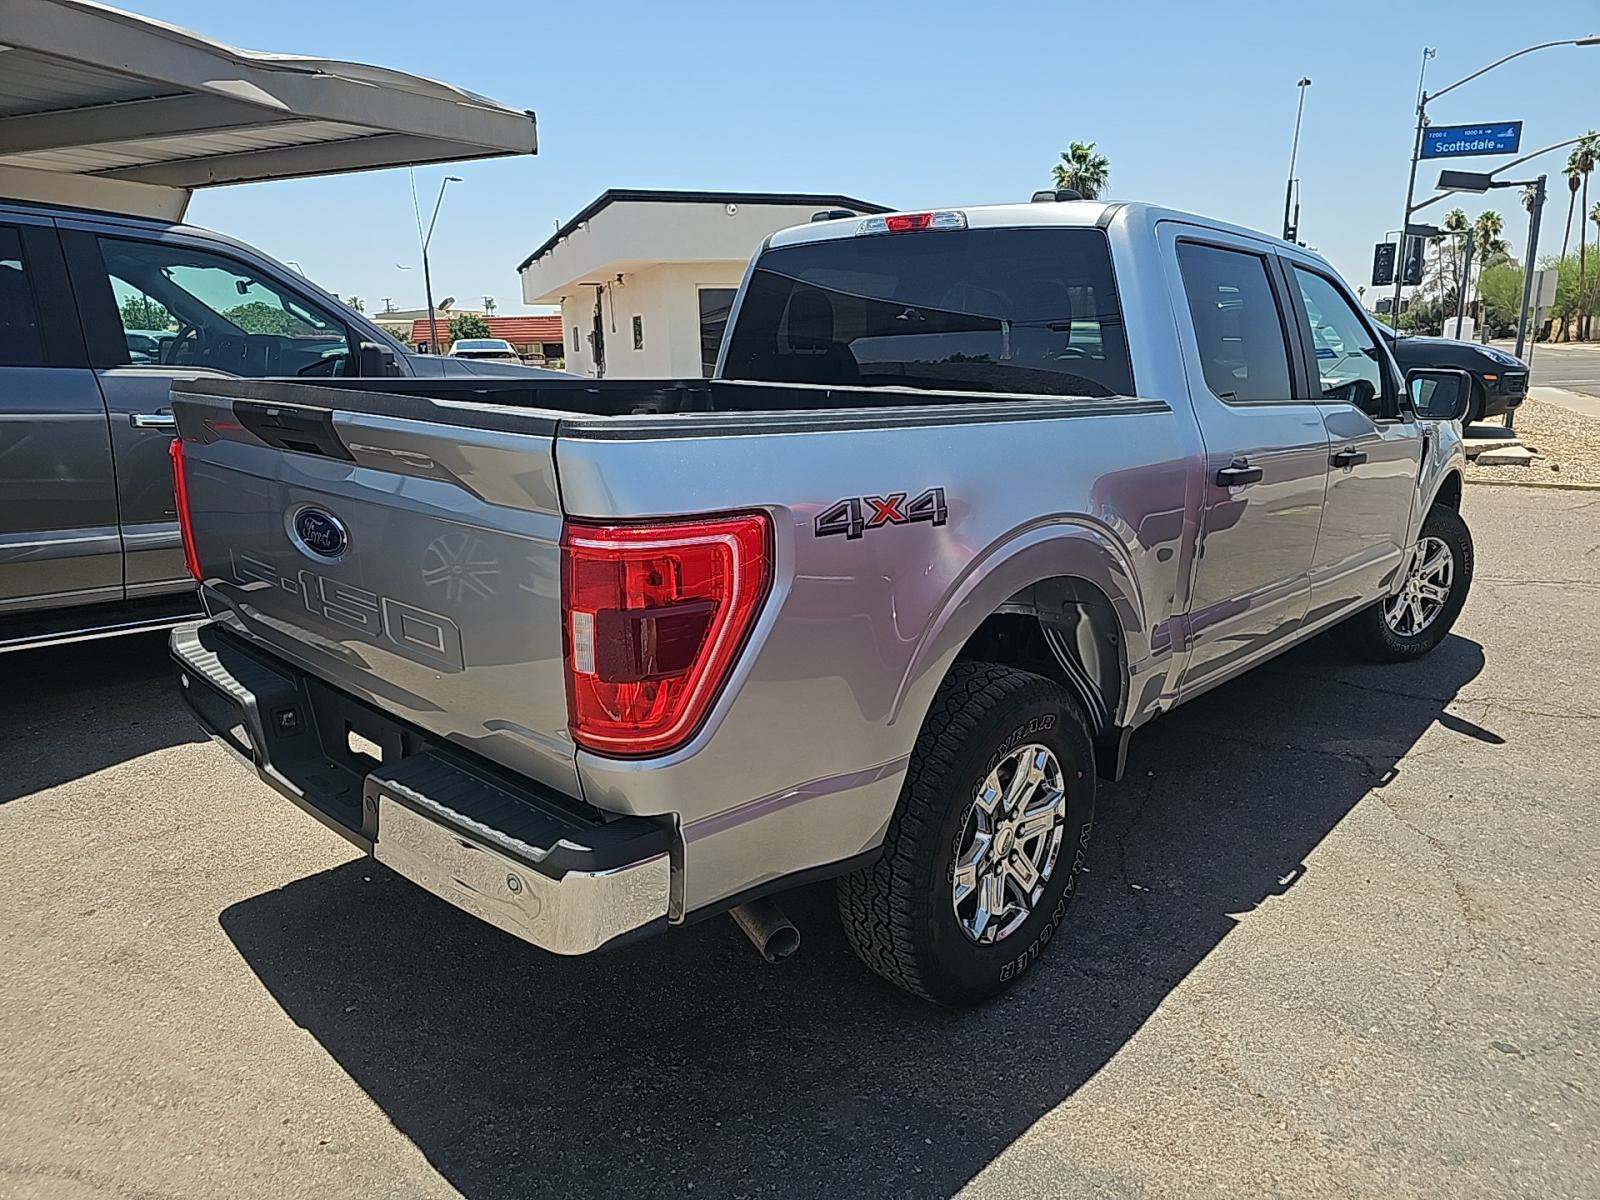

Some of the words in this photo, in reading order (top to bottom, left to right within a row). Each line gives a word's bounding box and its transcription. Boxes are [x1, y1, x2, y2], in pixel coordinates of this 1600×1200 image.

[1435, 139, 1495, 152] Scottsdale
[229, 547, 466, 674] F-150
[999, 822, 1092, 982] WRANGLER
